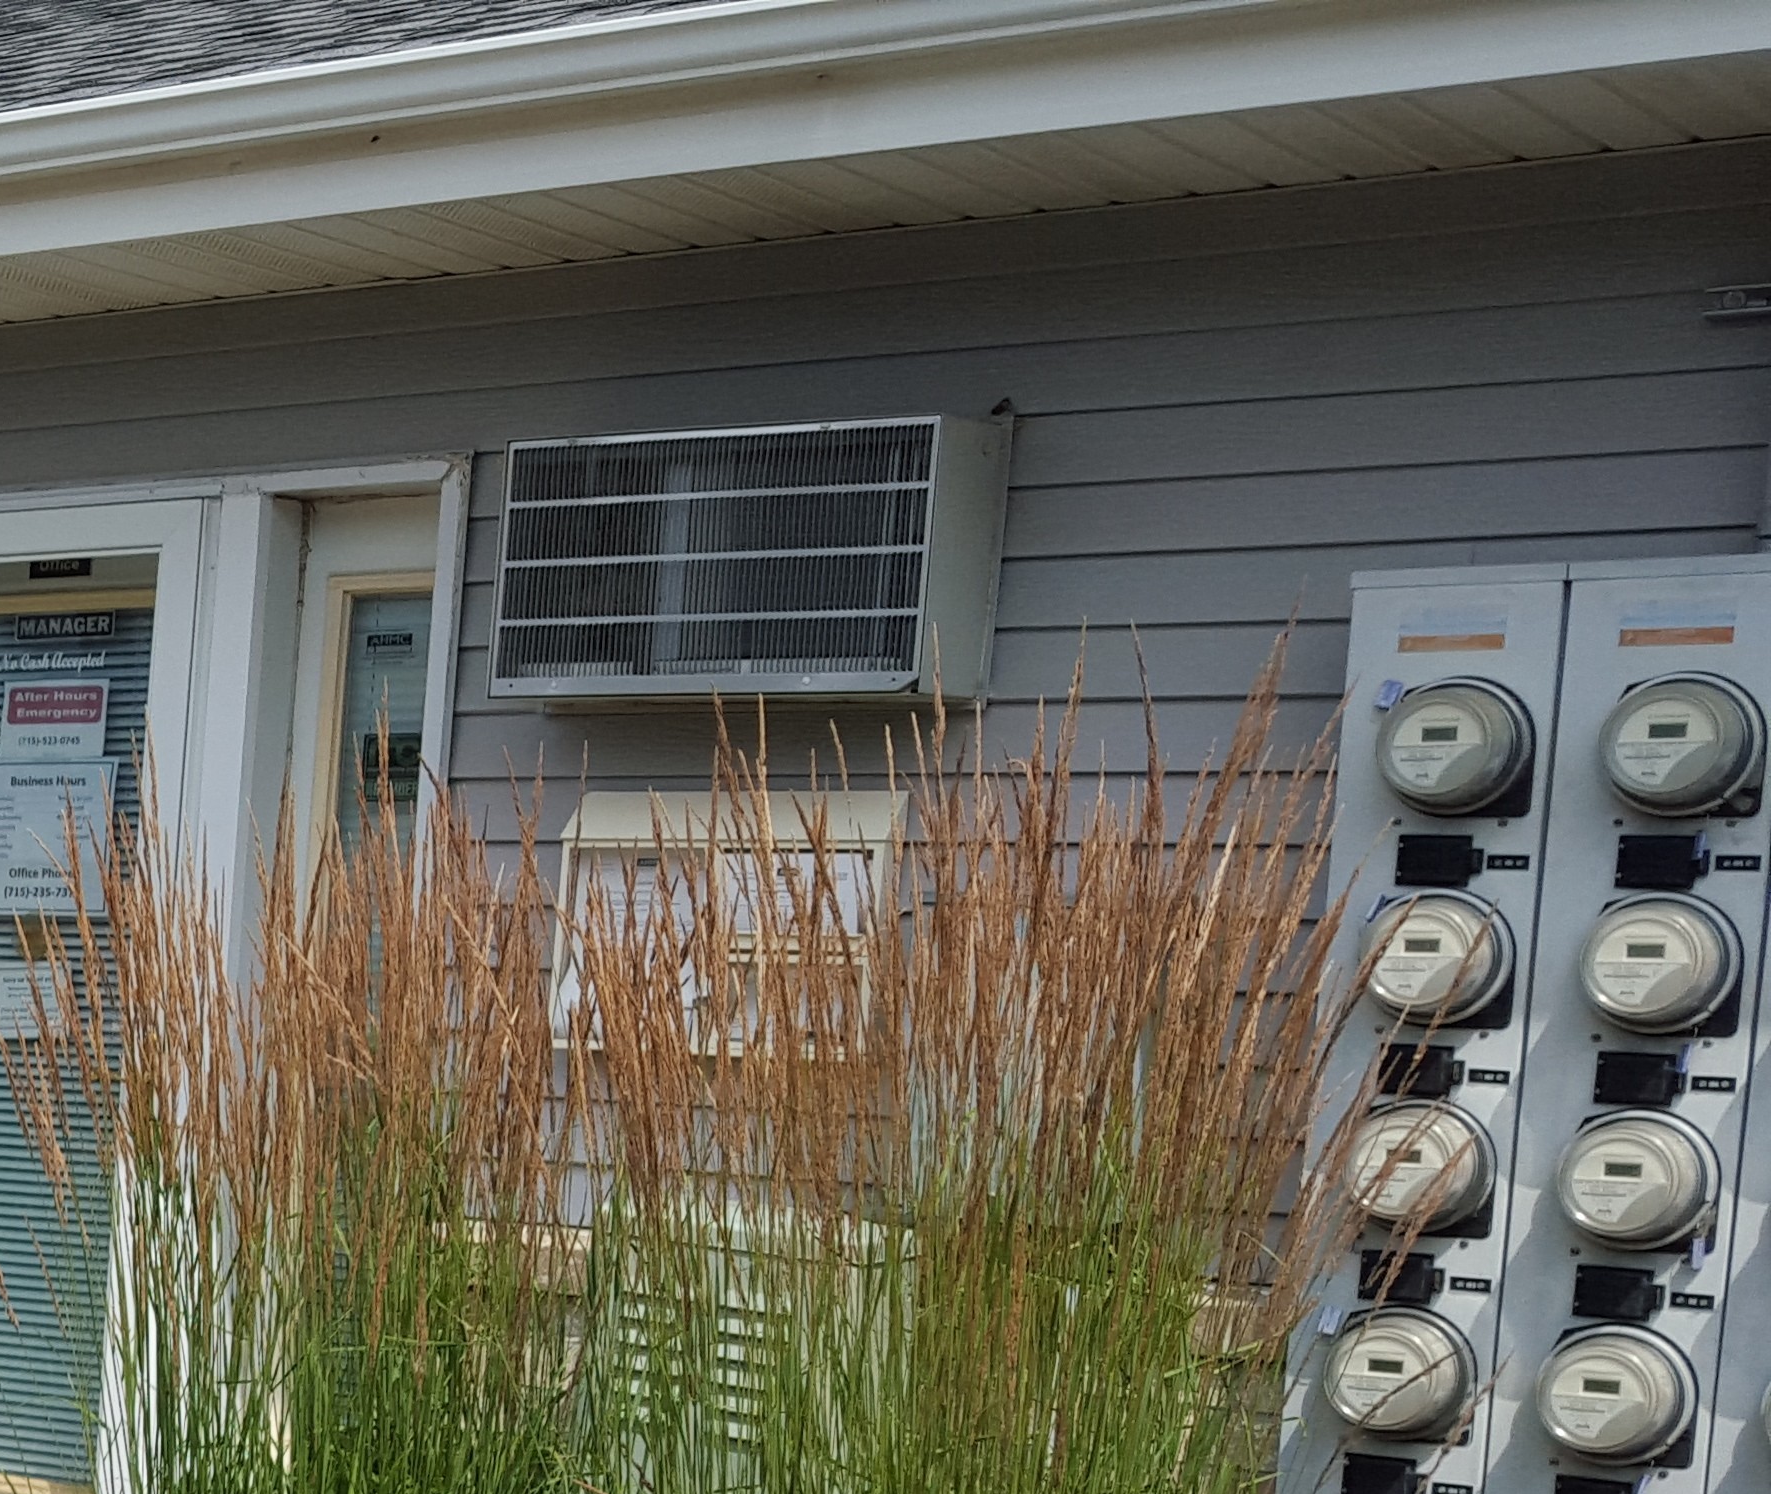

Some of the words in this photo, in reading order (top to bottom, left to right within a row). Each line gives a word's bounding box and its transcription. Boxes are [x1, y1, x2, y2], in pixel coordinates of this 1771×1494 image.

[20, 615, 110, 636] MANAGER
[20, 652, 49, 670] Cash
[51, 649, 105, 673] Accepted
[15, 692, 49, 702] After
[53, 691, 97, 701] Hours
[16, 707, 97, 719] Emergency
[10, 776, 53, 786] Business
[9, 868, 38, 878] Office
[42, 867, 74, 879] Phoe
